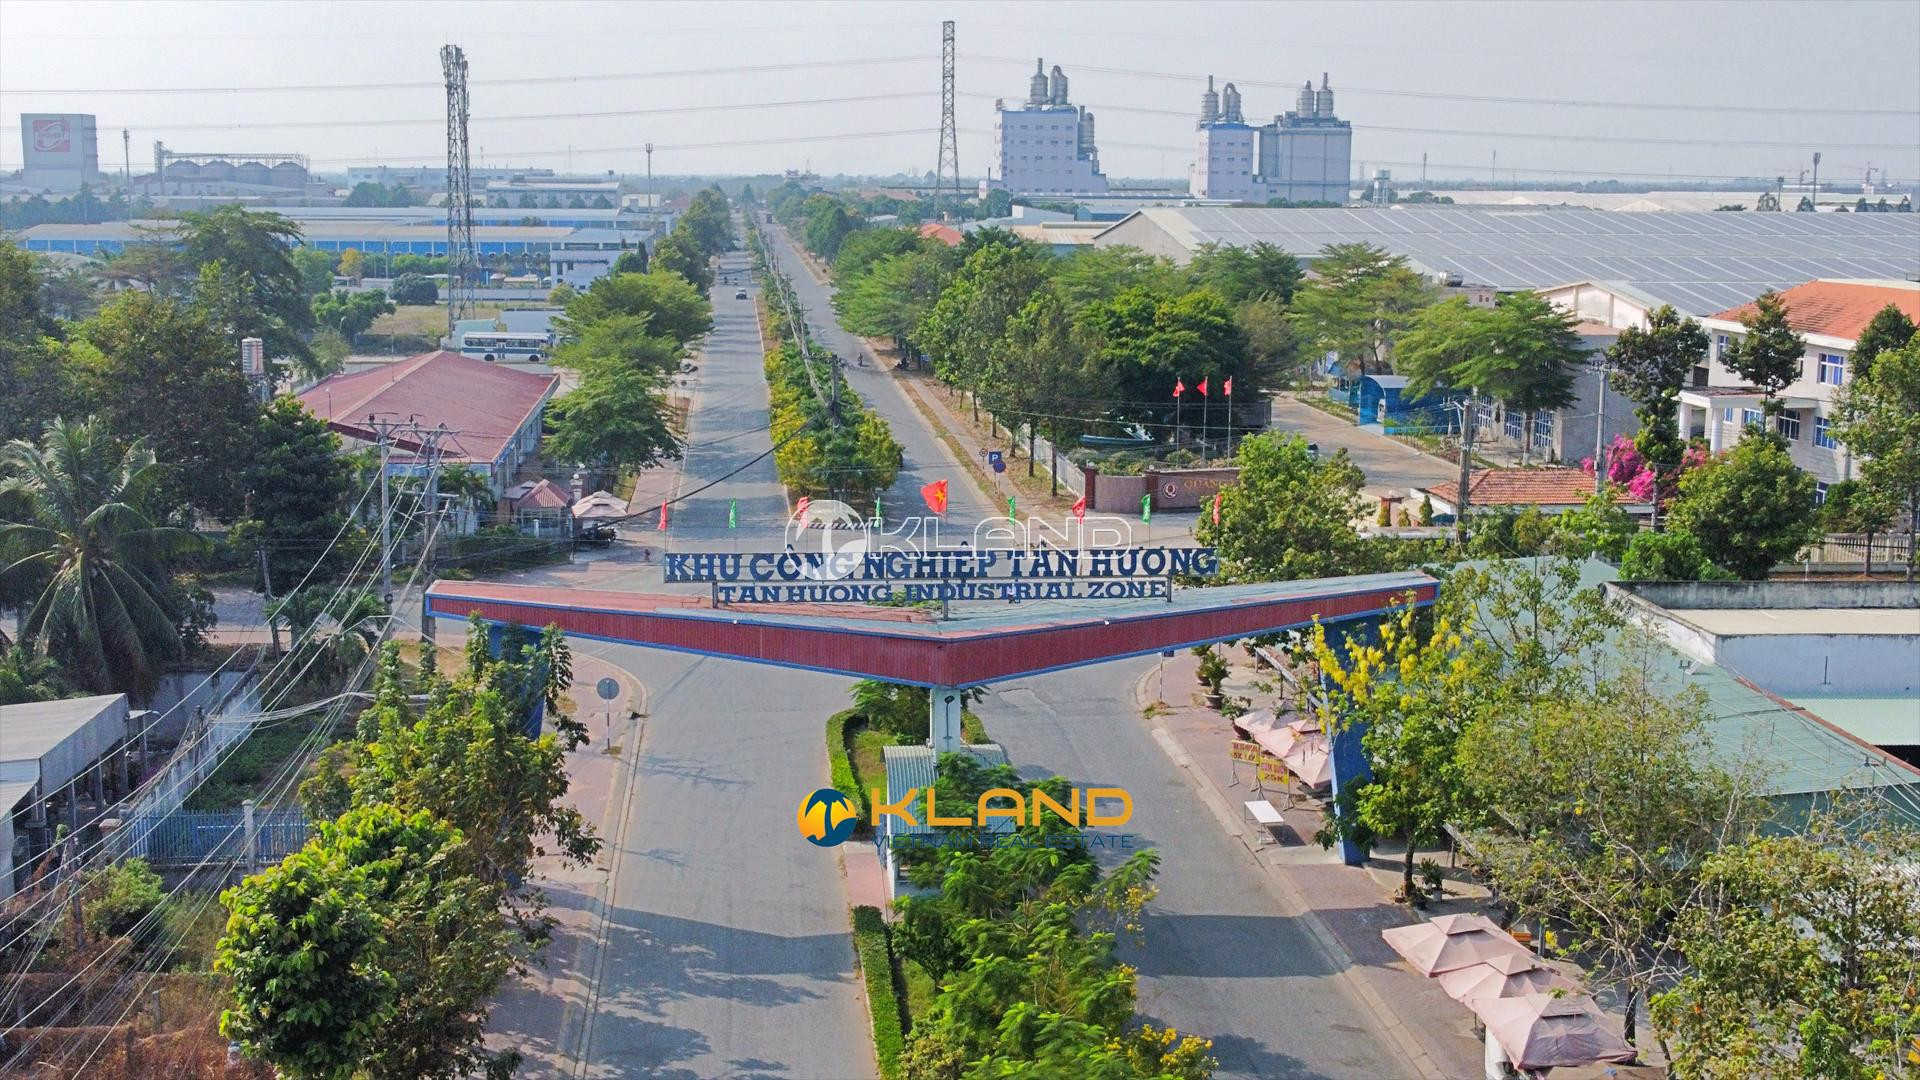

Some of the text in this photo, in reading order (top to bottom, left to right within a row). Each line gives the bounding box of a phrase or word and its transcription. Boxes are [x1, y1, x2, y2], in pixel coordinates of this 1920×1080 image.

[667, 553, 742, 581] KHU
[719, 580, 1166, 602] TAN HUONG INDUSTRIAL ZONE
